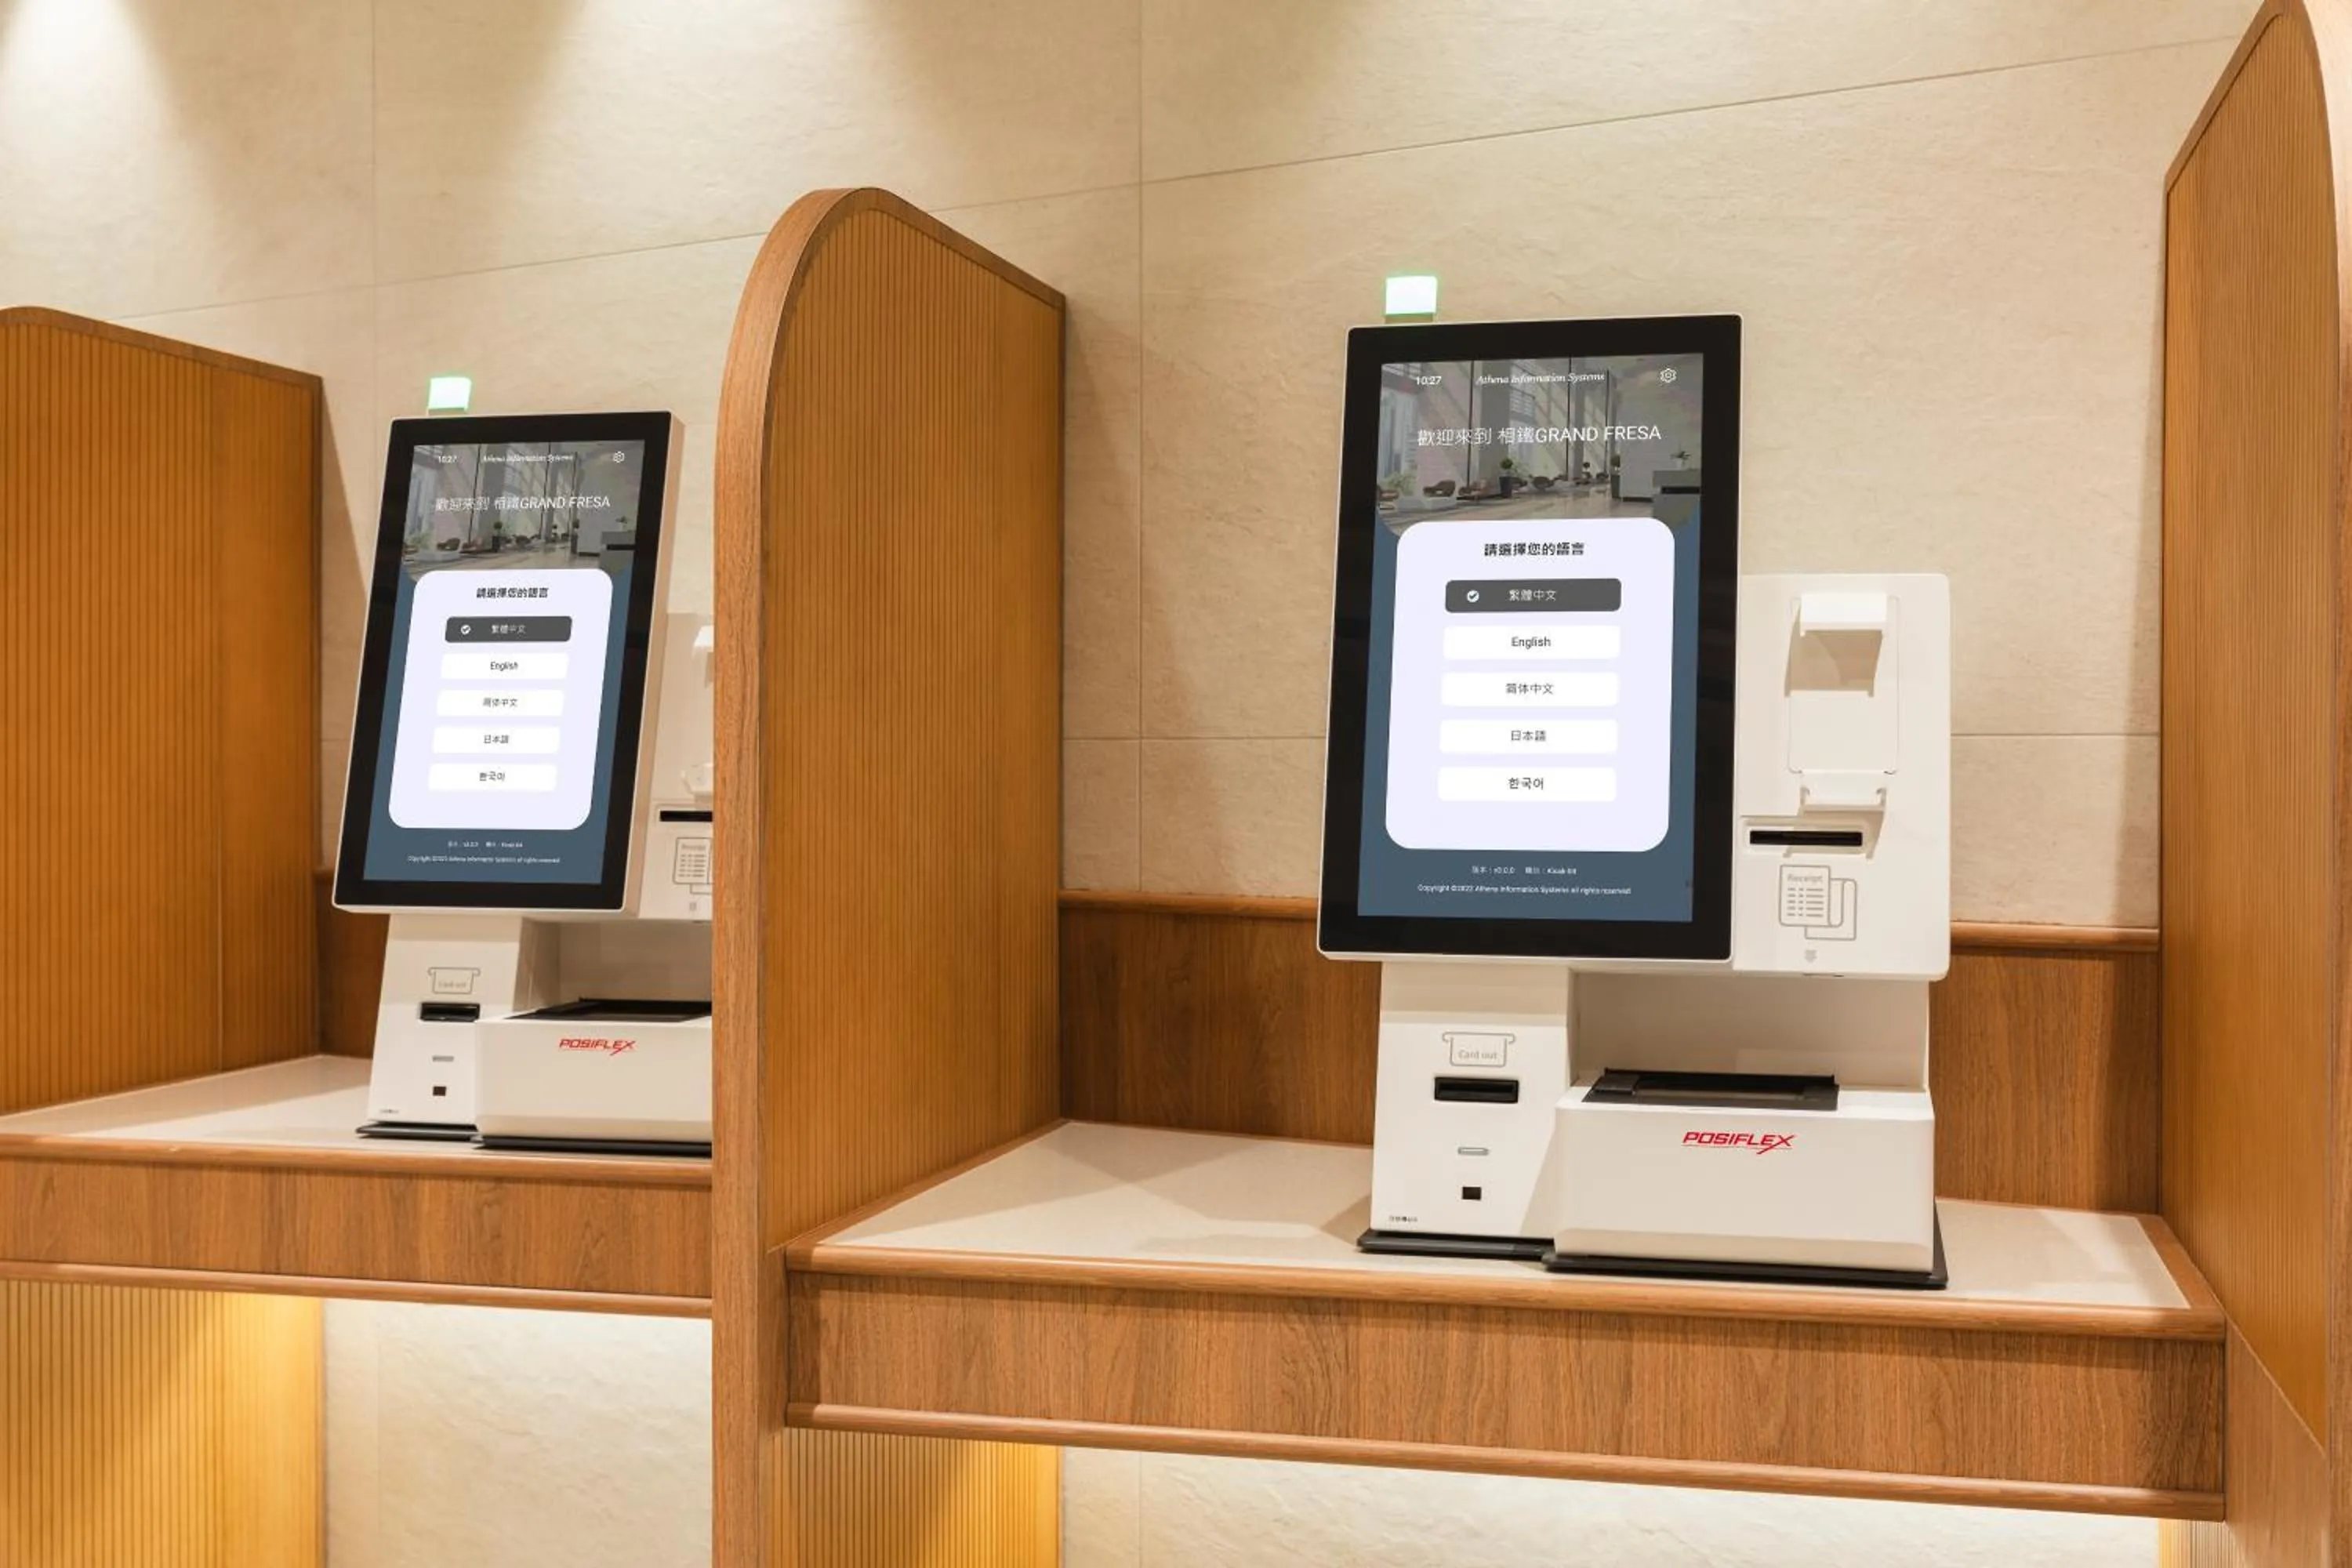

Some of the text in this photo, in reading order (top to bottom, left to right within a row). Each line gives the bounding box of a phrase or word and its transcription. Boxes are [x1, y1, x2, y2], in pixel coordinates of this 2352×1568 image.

[1415, 376, 1442, 386] 10:27
[1475, 372, 1605, 385] Athena Information Systems
[1417, 426, 1492, 446] 歡迎來到
[1603, 425, 1662, 441] FRESA
[568, 495, 611, 509] FRESA
[1484, 542, 1584, 557] 請選擇您的語言
[1508, 589, 1556, 601] 繁體中文
[1511, 636, 1552, 649] English
[490, 661, 518, 672] English
[484, 734, 510, 744] 日本語
[1511, 730, 1547, 742] 日本語
[1508, 777, 1544, 790] 한국어
[559, 1038, 636, 1056] POSIFLEX
[1458, 1050, 1479, 1059] Card
[1682, 1131, 1795, 1155] POSIFLEX
